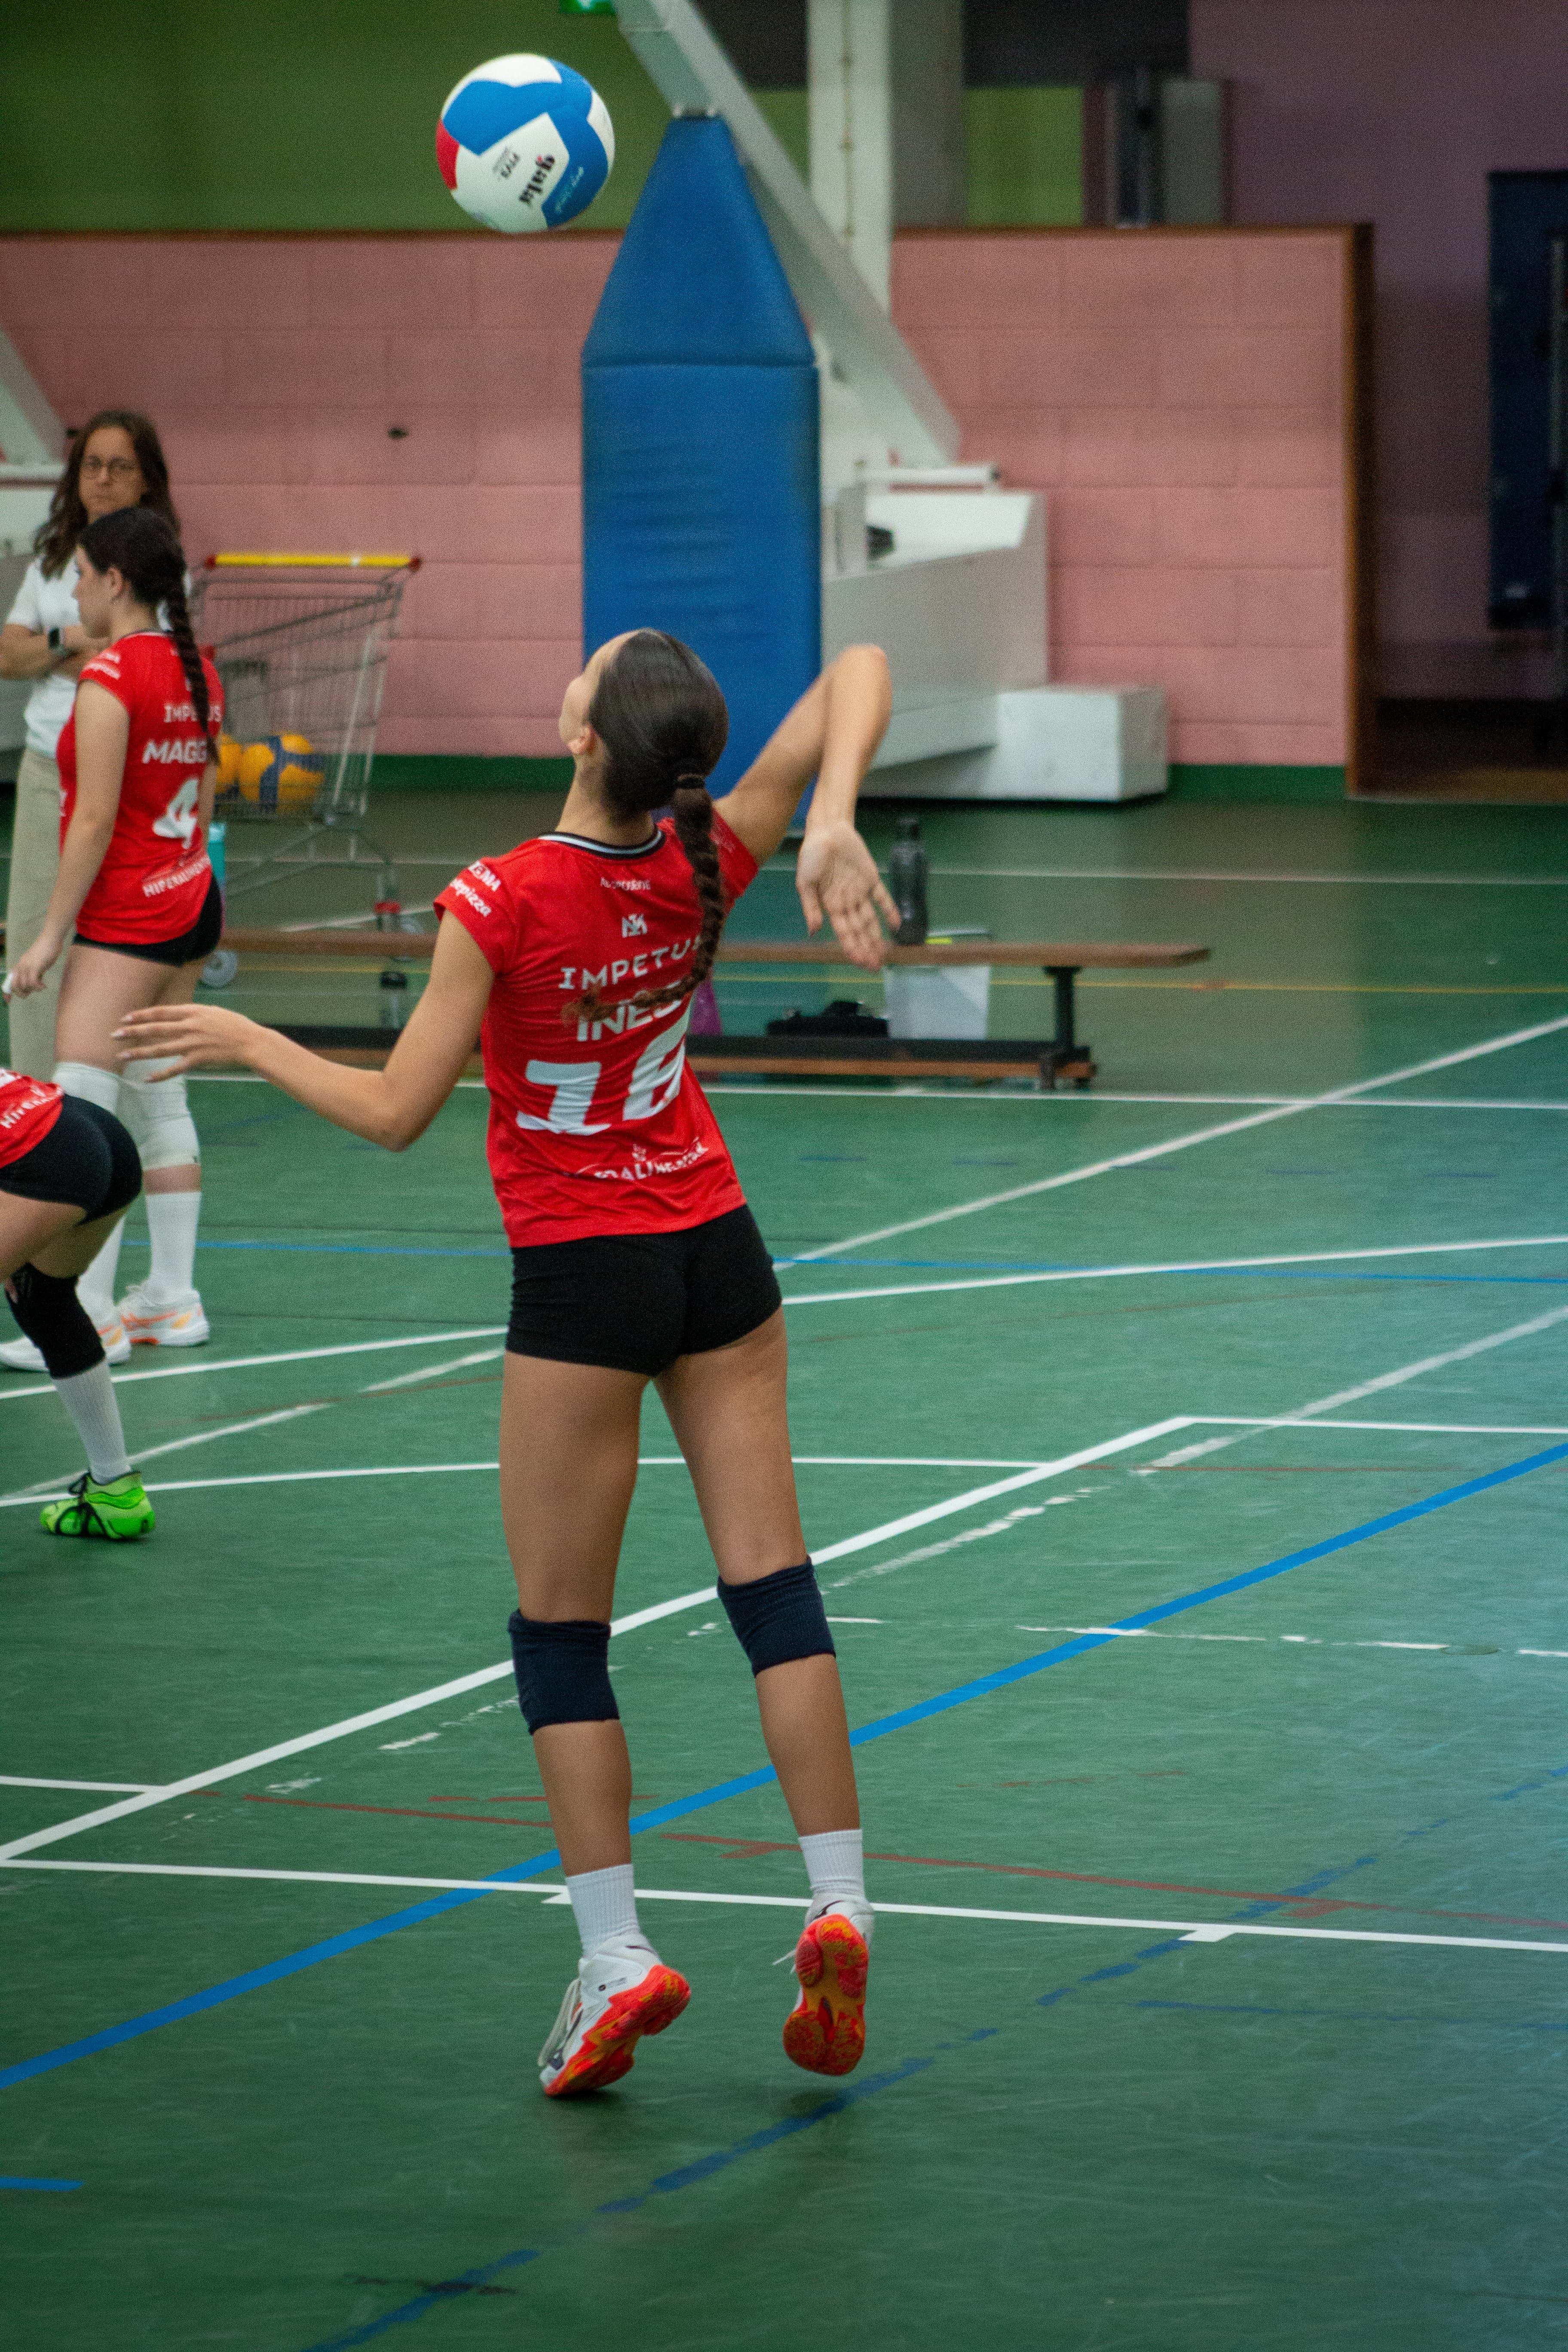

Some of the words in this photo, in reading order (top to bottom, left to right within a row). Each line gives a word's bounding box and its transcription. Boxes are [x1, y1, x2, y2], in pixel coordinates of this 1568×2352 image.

[519, 153, 556, 207] gala
[153, 777, 199, 850] 4
[515, 993, 693, 1136] 16
